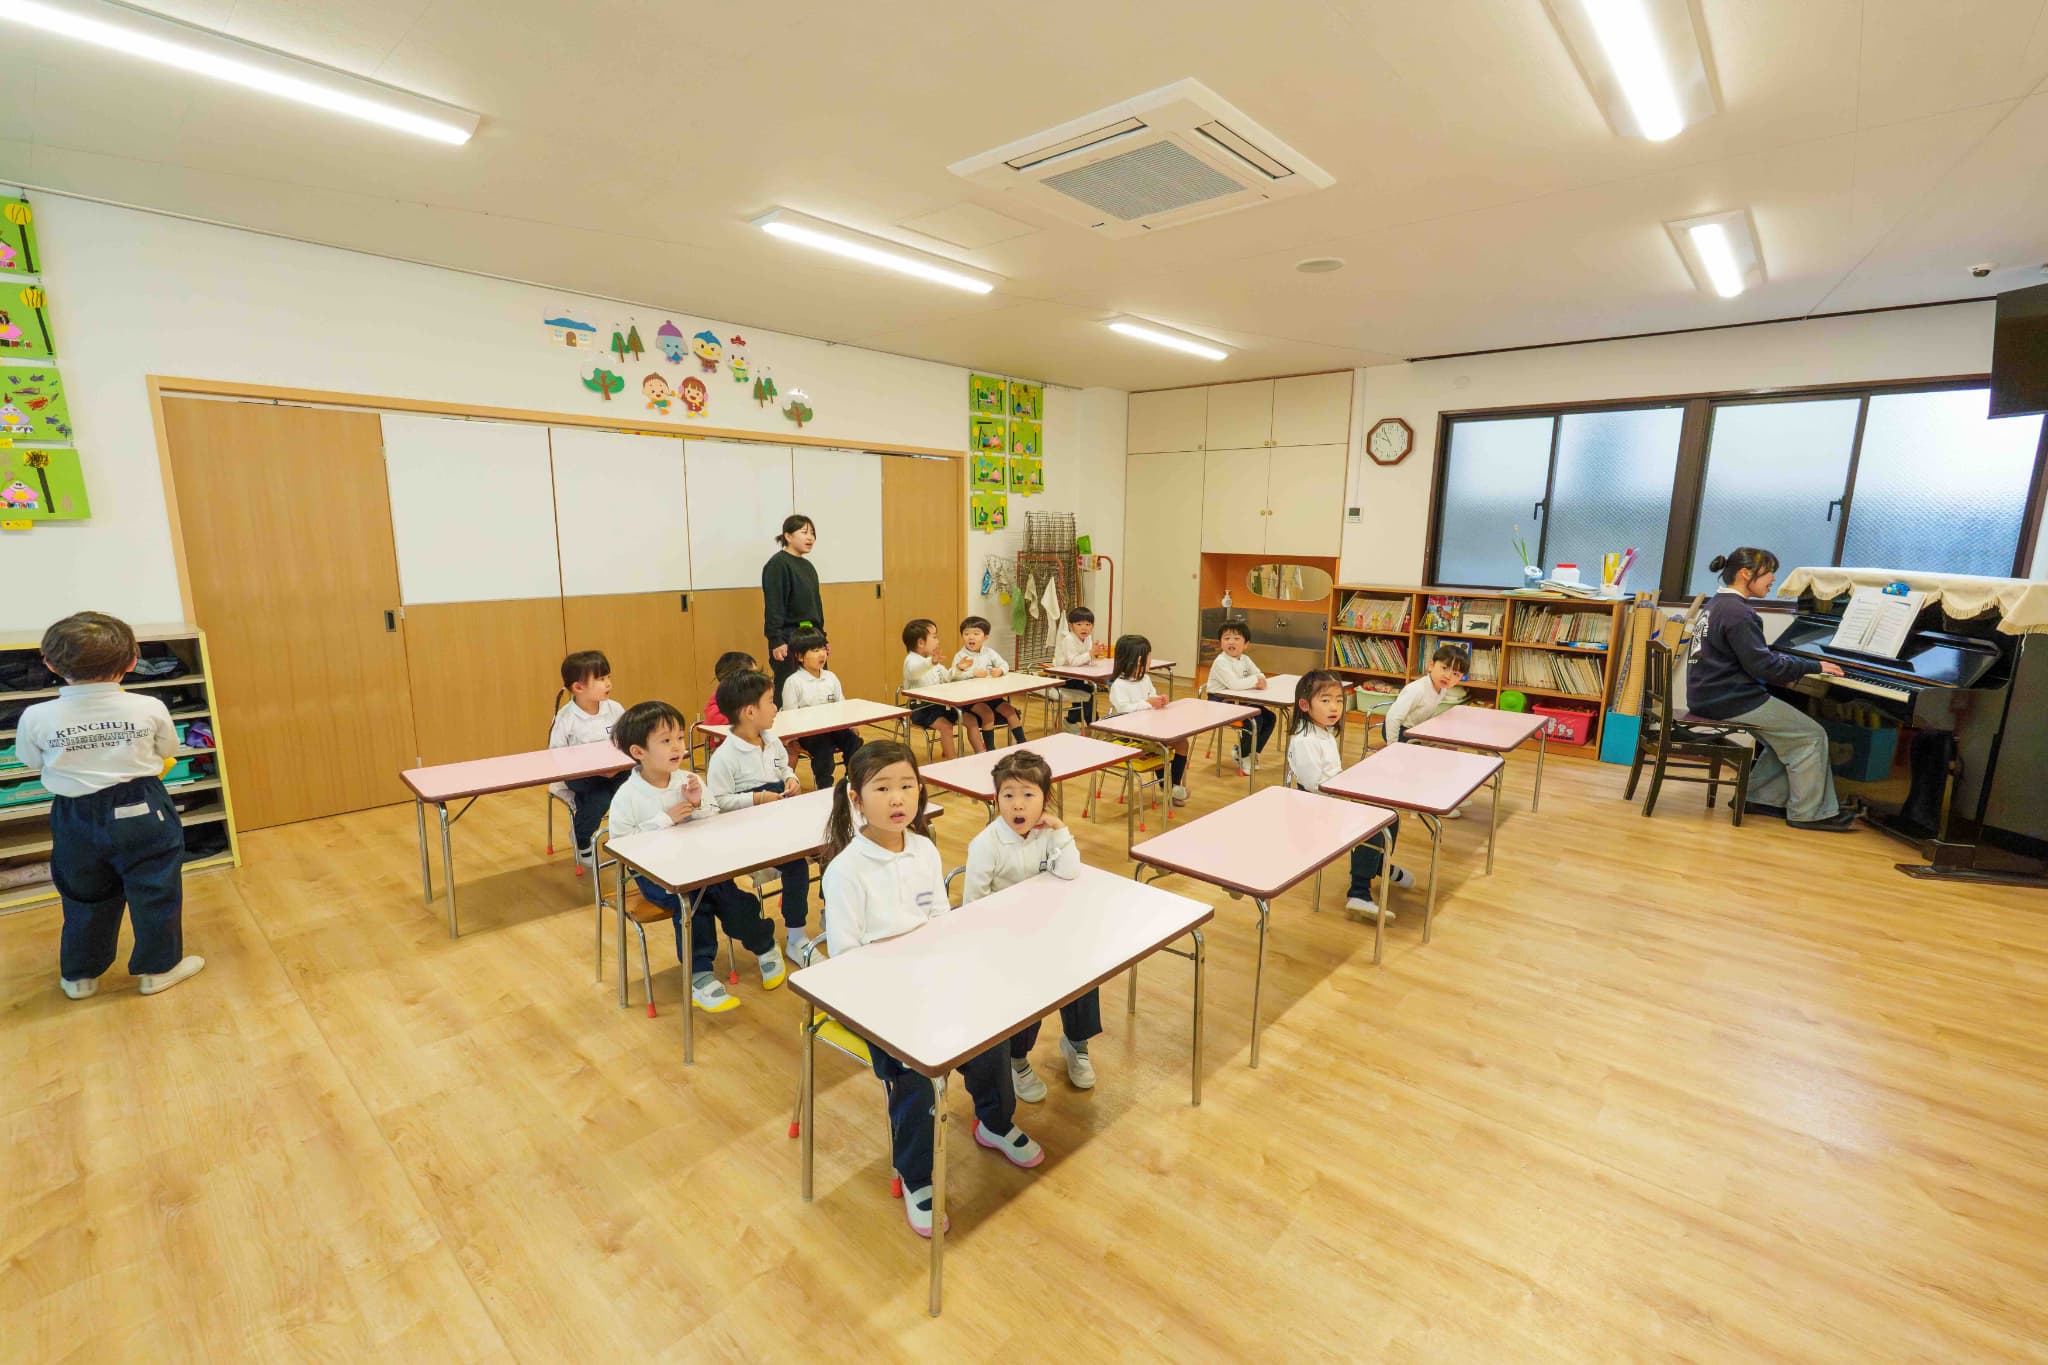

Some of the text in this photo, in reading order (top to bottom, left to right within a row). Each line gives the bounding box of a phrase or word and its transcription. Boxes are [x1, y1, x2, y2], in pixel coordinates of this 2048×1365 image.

[56, 721, 135, 738] KENCHUJI
[65, 740, 120, 752] SINCE 1927
